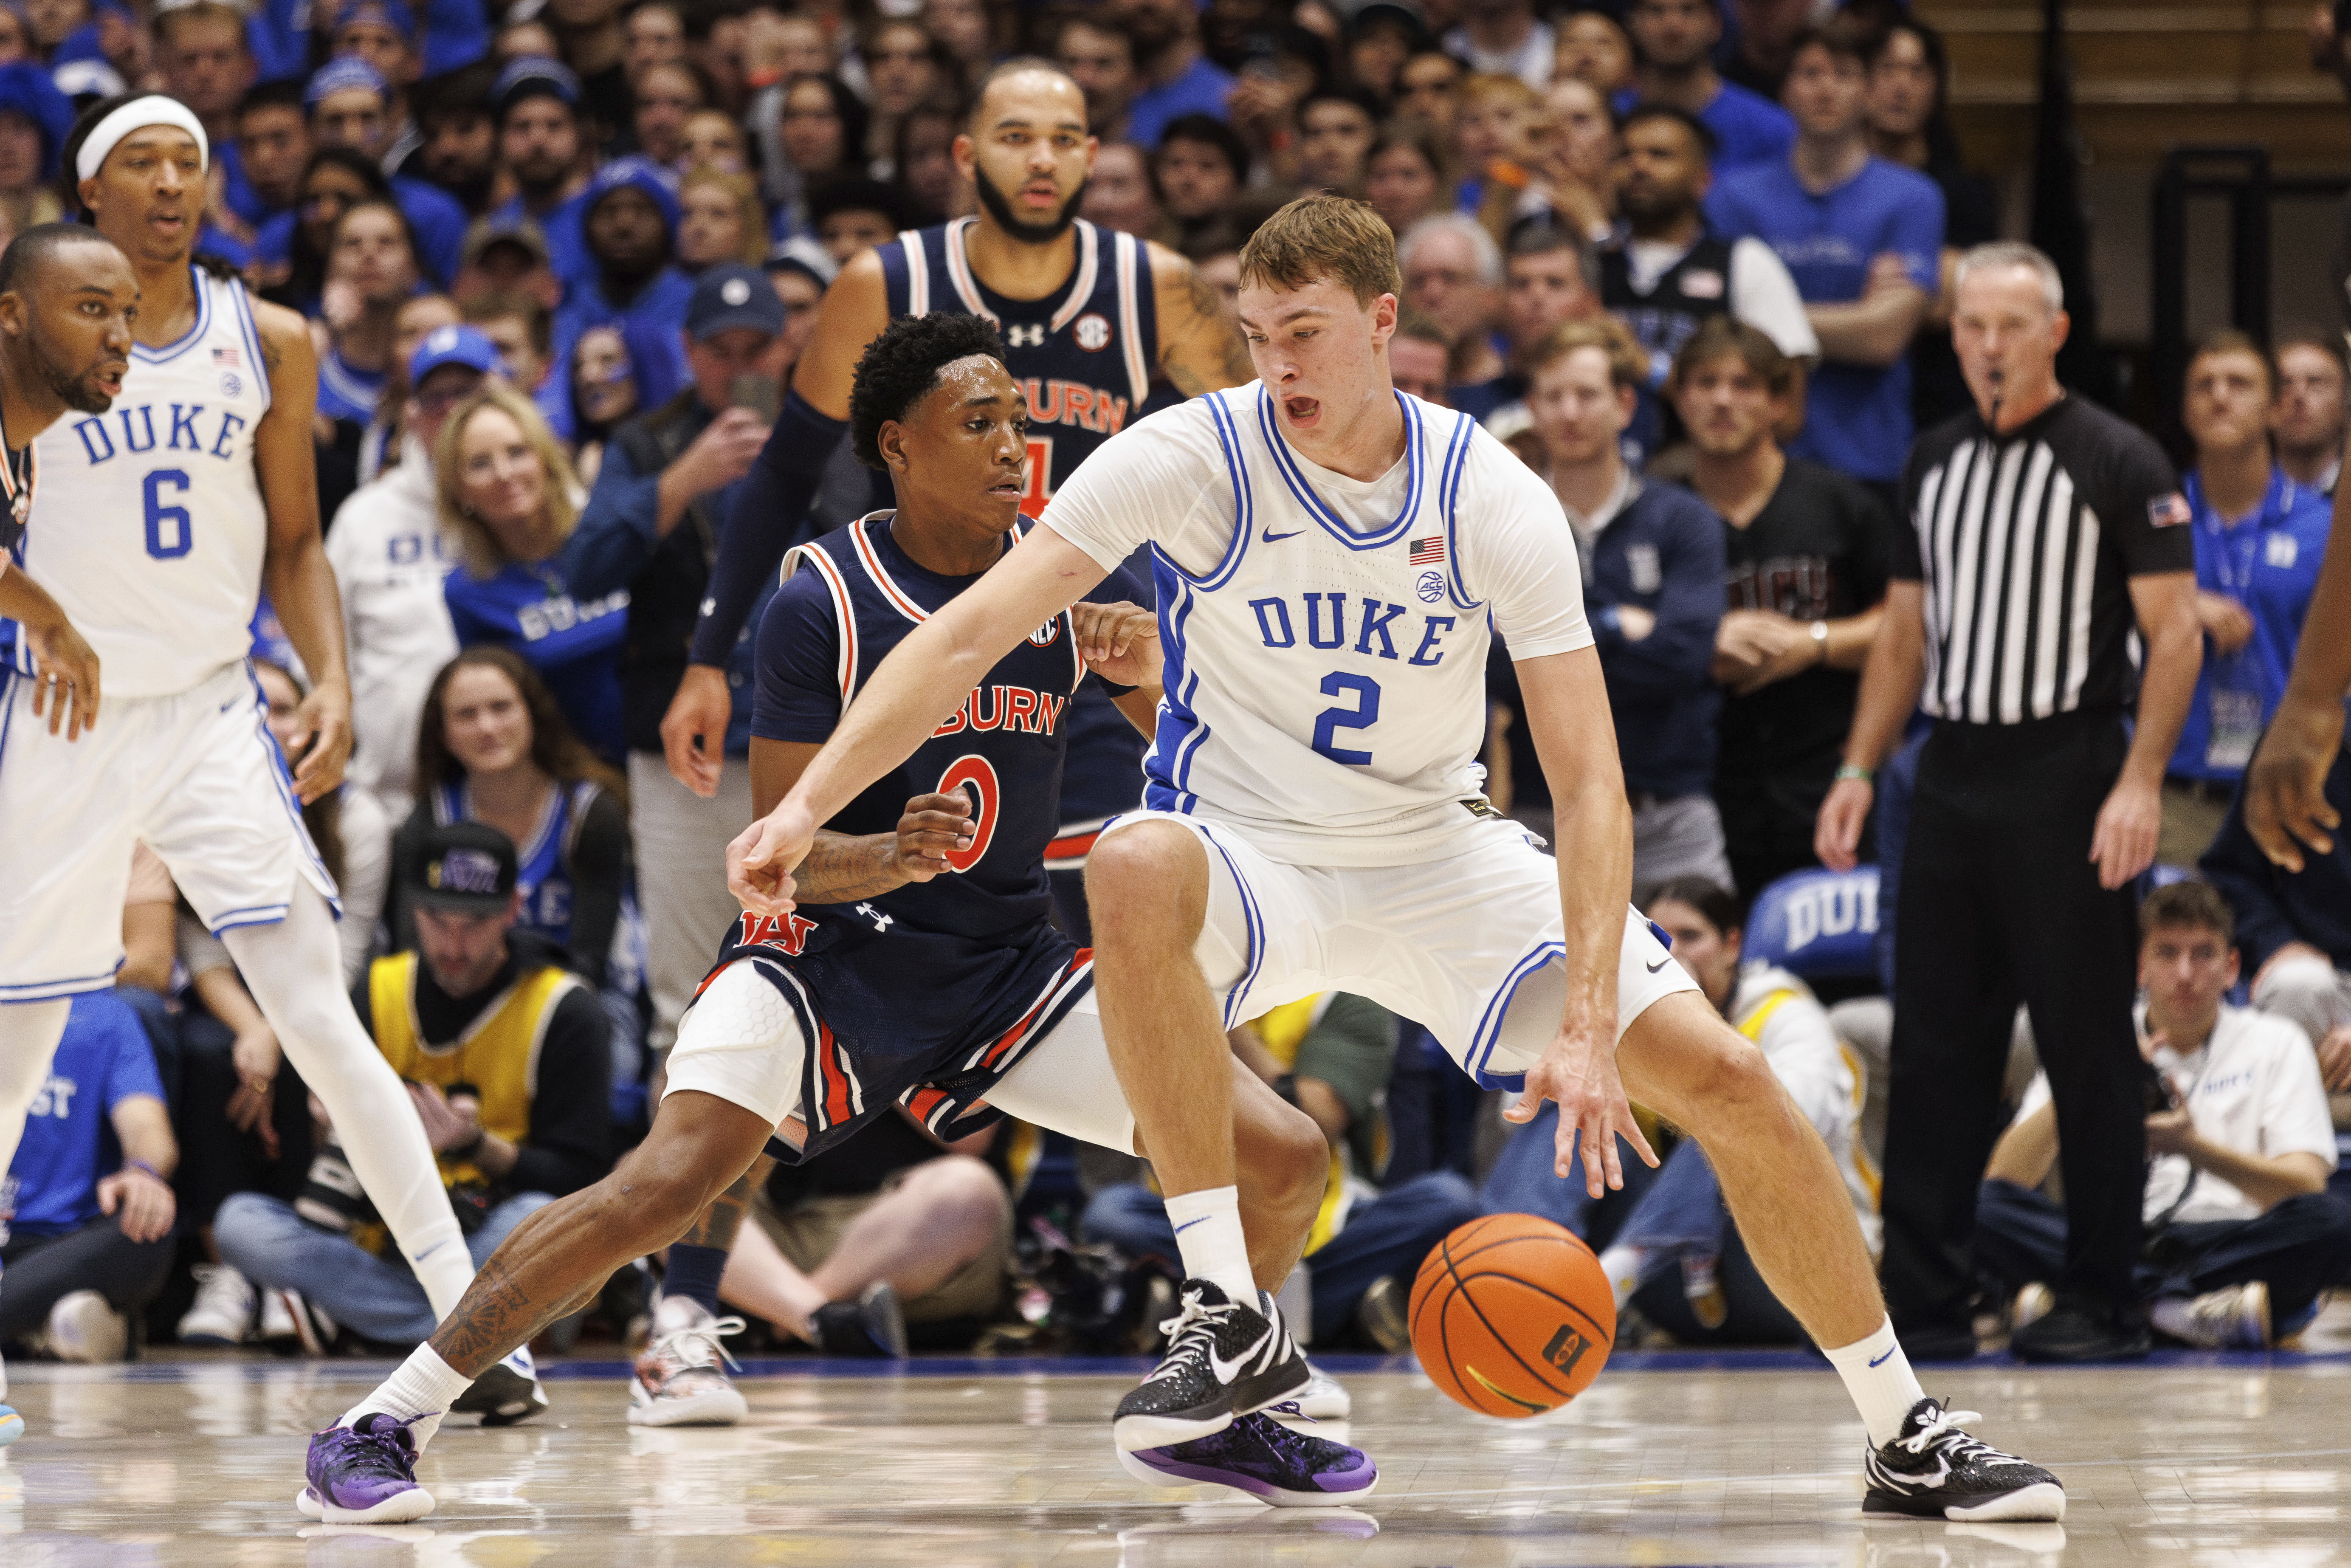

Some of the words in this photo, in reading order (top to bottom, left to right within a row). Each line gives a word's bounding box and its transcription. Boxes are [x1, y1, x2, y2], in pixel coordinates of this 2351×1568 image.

[72, 403, 245, 465] DUKE
[142, 469, 193, 562] 6
[1420, 581, 1443, 590] ACC
[1029, 617, 1056, 644] EC
[1248, 592, 1456, 666] DUKE
[931, 685, 1064, 739] BURN
[1311, 671, 1381, 766] 2
[936, 754, 1000, 874] 0
